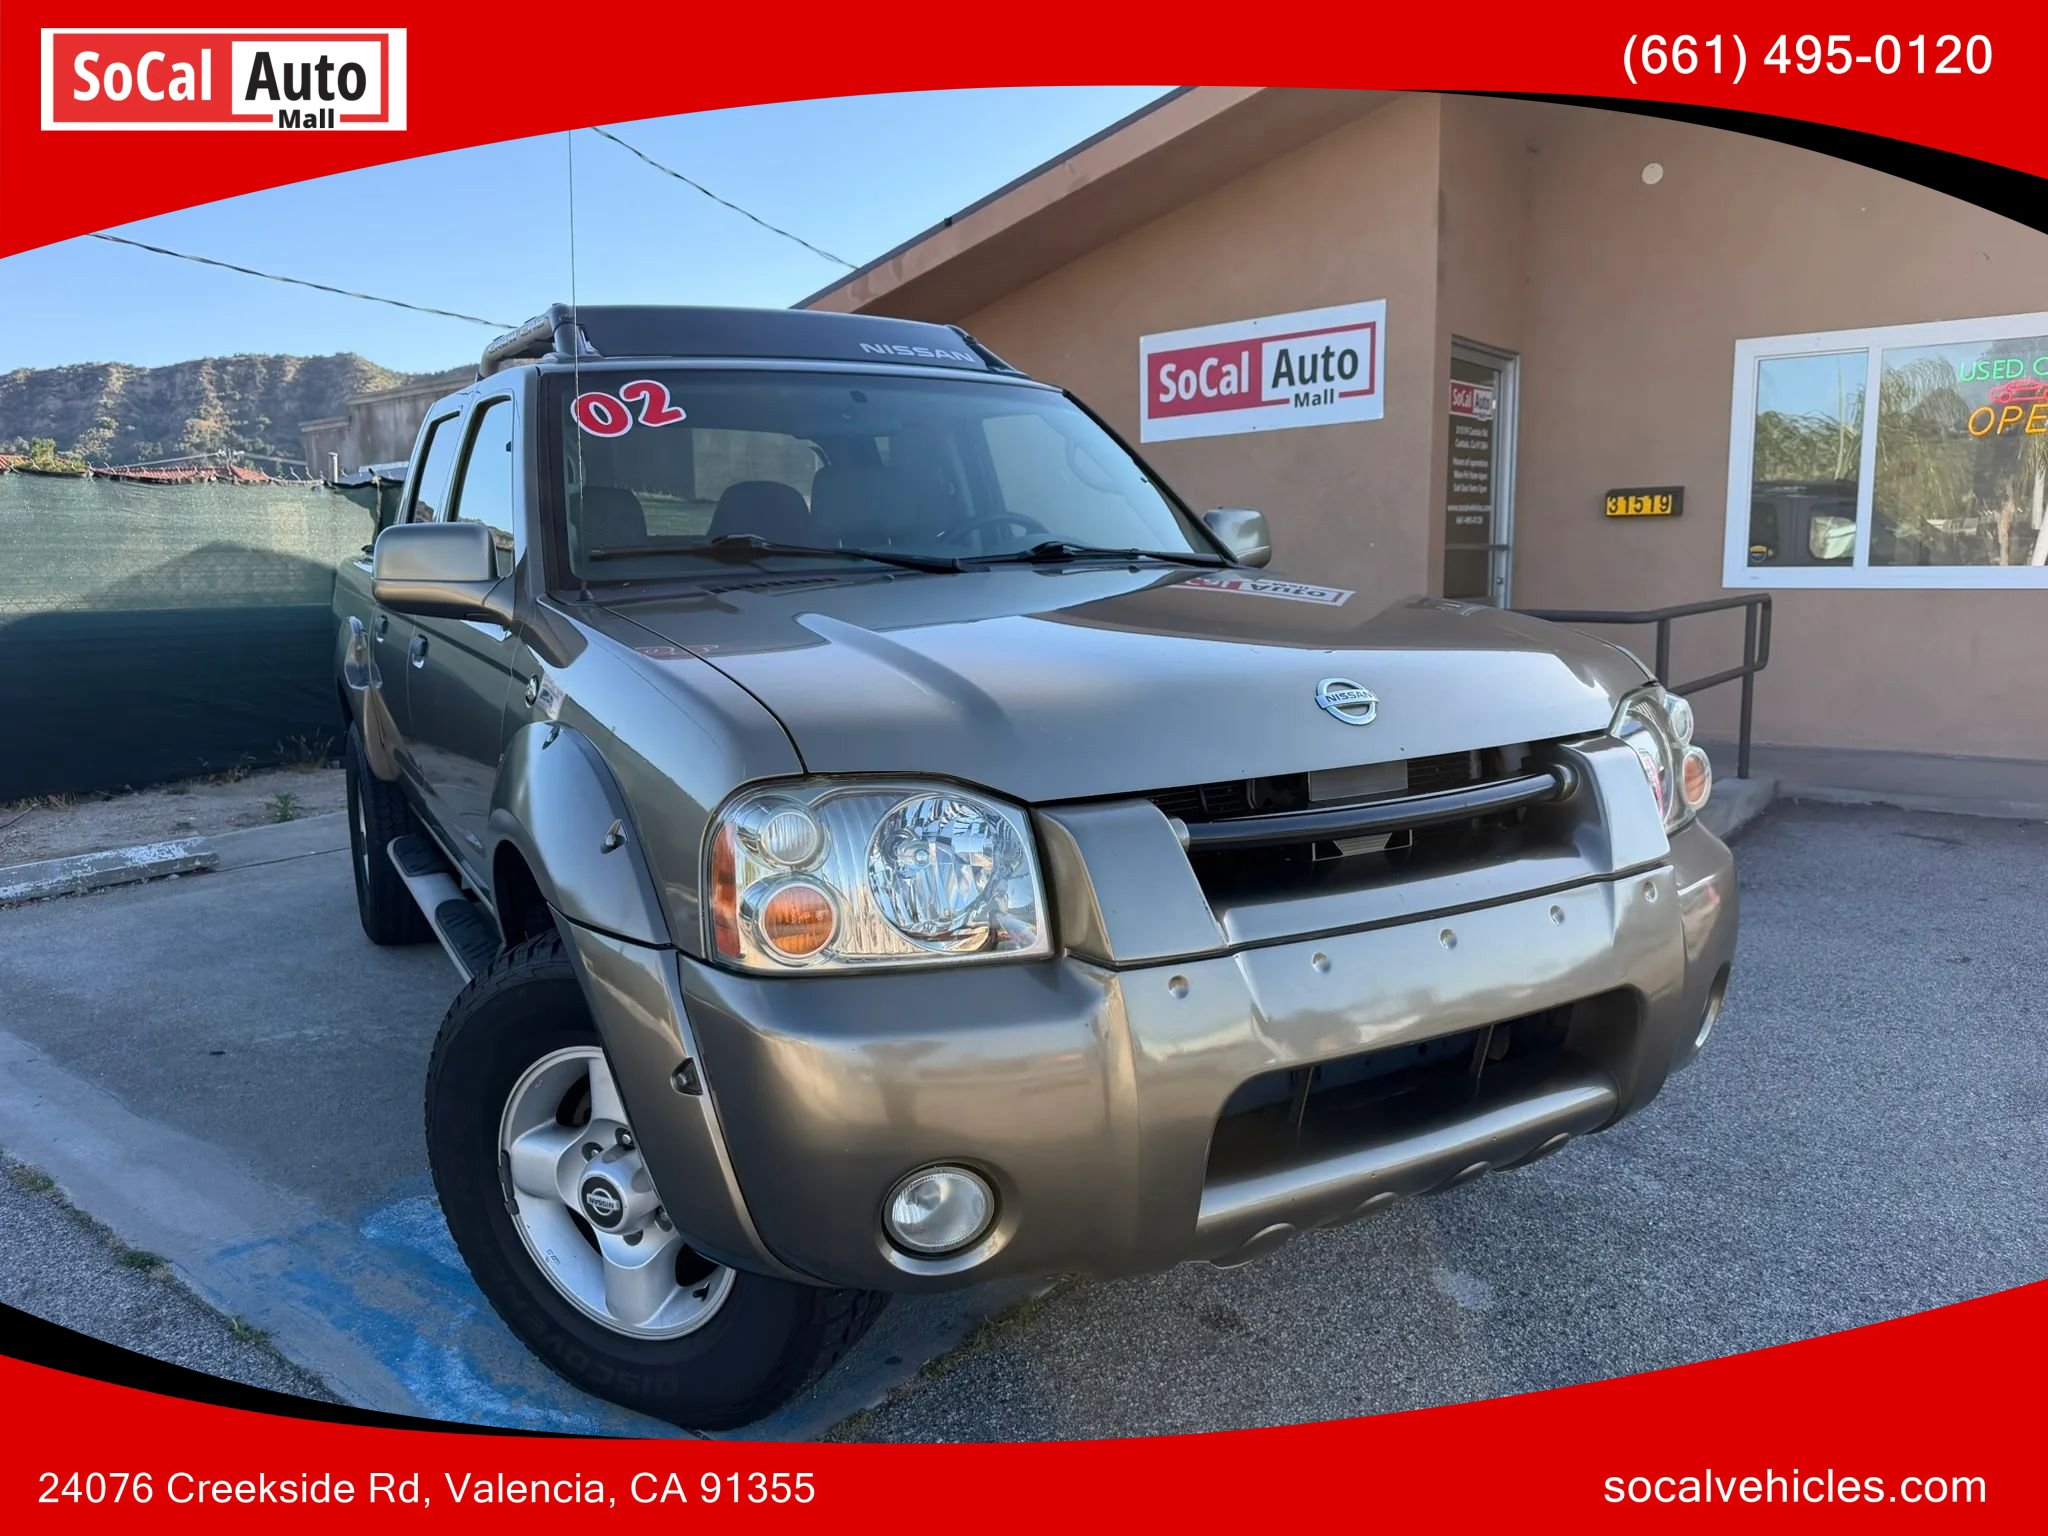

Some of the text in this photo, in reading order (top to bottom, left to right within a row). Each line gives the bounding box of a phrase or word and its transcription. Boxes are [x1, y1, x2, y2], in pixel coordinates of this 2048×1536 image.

[859, 342, 977, 363] NISSAN
[1158, 345, 1359, 403] SoCal Auto
[1959, 358, 2025, 382] USED
[570, 379, 687, 437] 02
[1294, 388, 1335, 408] Mall
[1967, 402, 2048, 436] OPE
[1607, 493, 1671, 514] 31519
[1325, 690, 1374, 703] NISSAN
